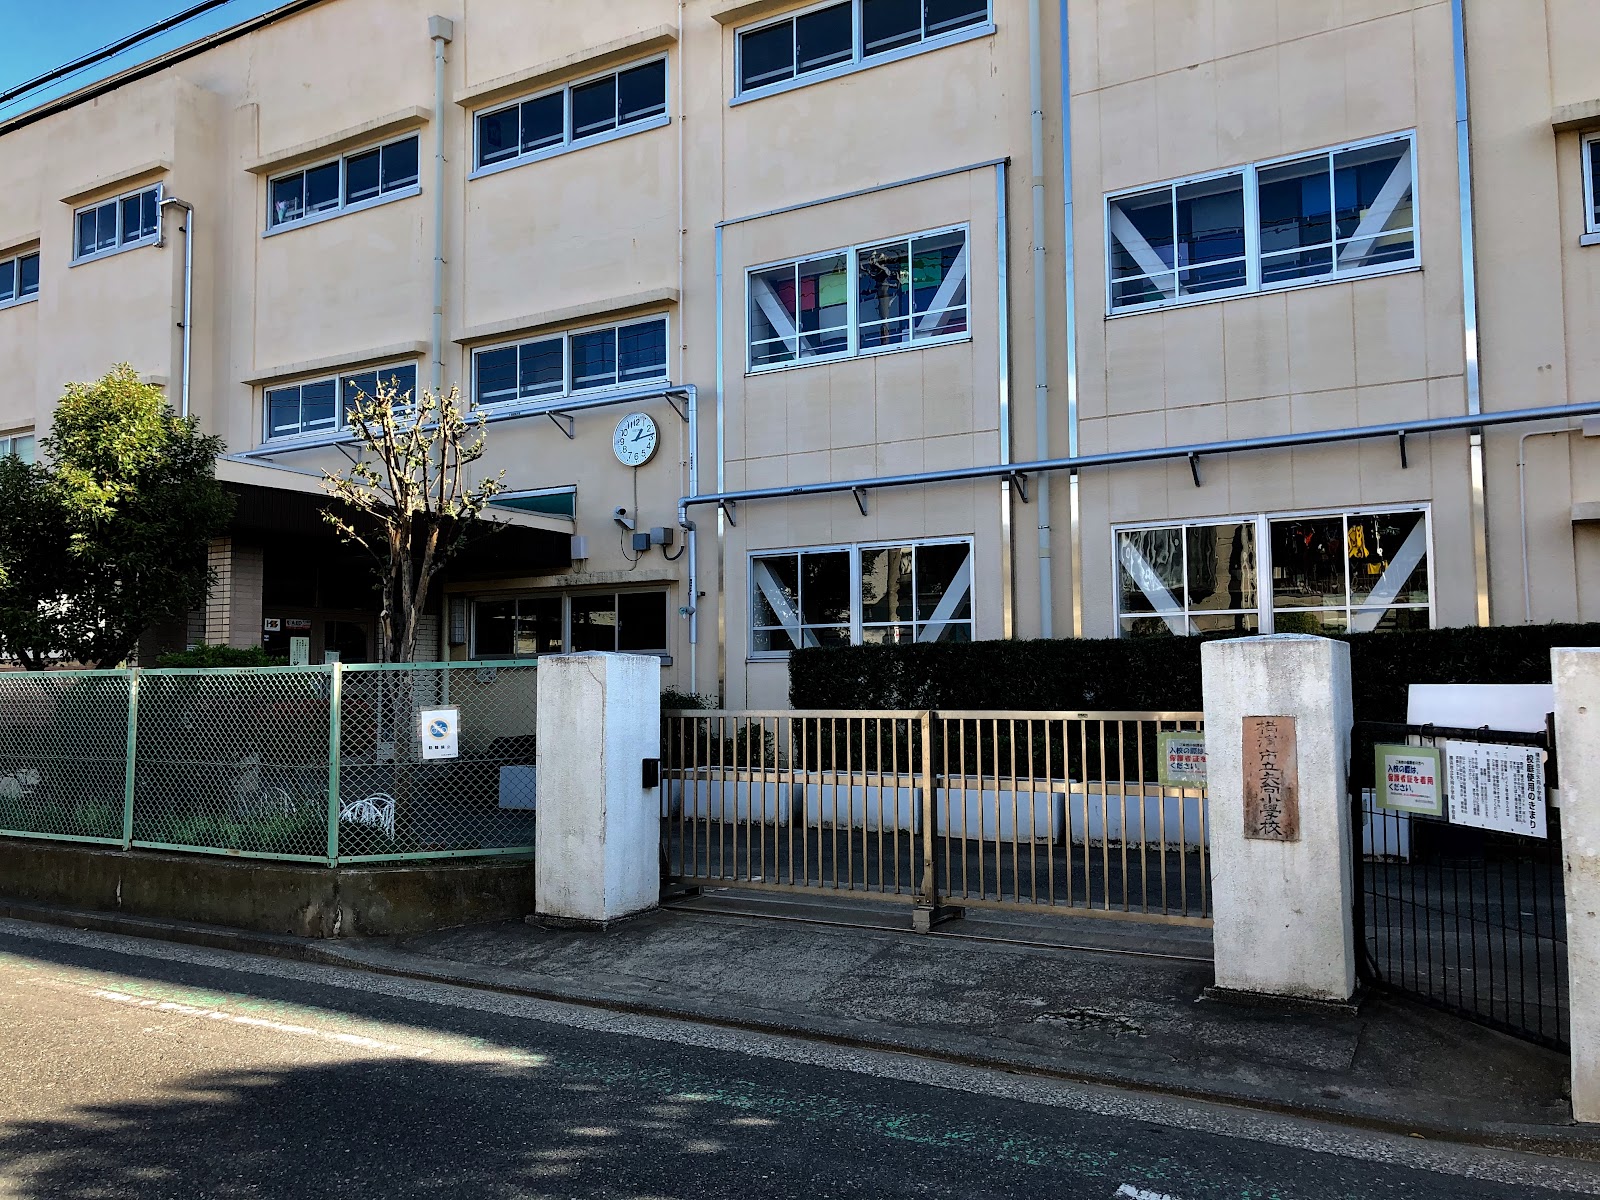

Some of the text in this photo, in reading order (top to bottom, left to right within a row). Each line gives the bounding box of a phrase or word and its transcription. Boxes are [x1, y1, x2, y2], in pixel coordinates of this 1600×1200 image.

[1526, 754, 1536, 829] 校庭使用のきまり
